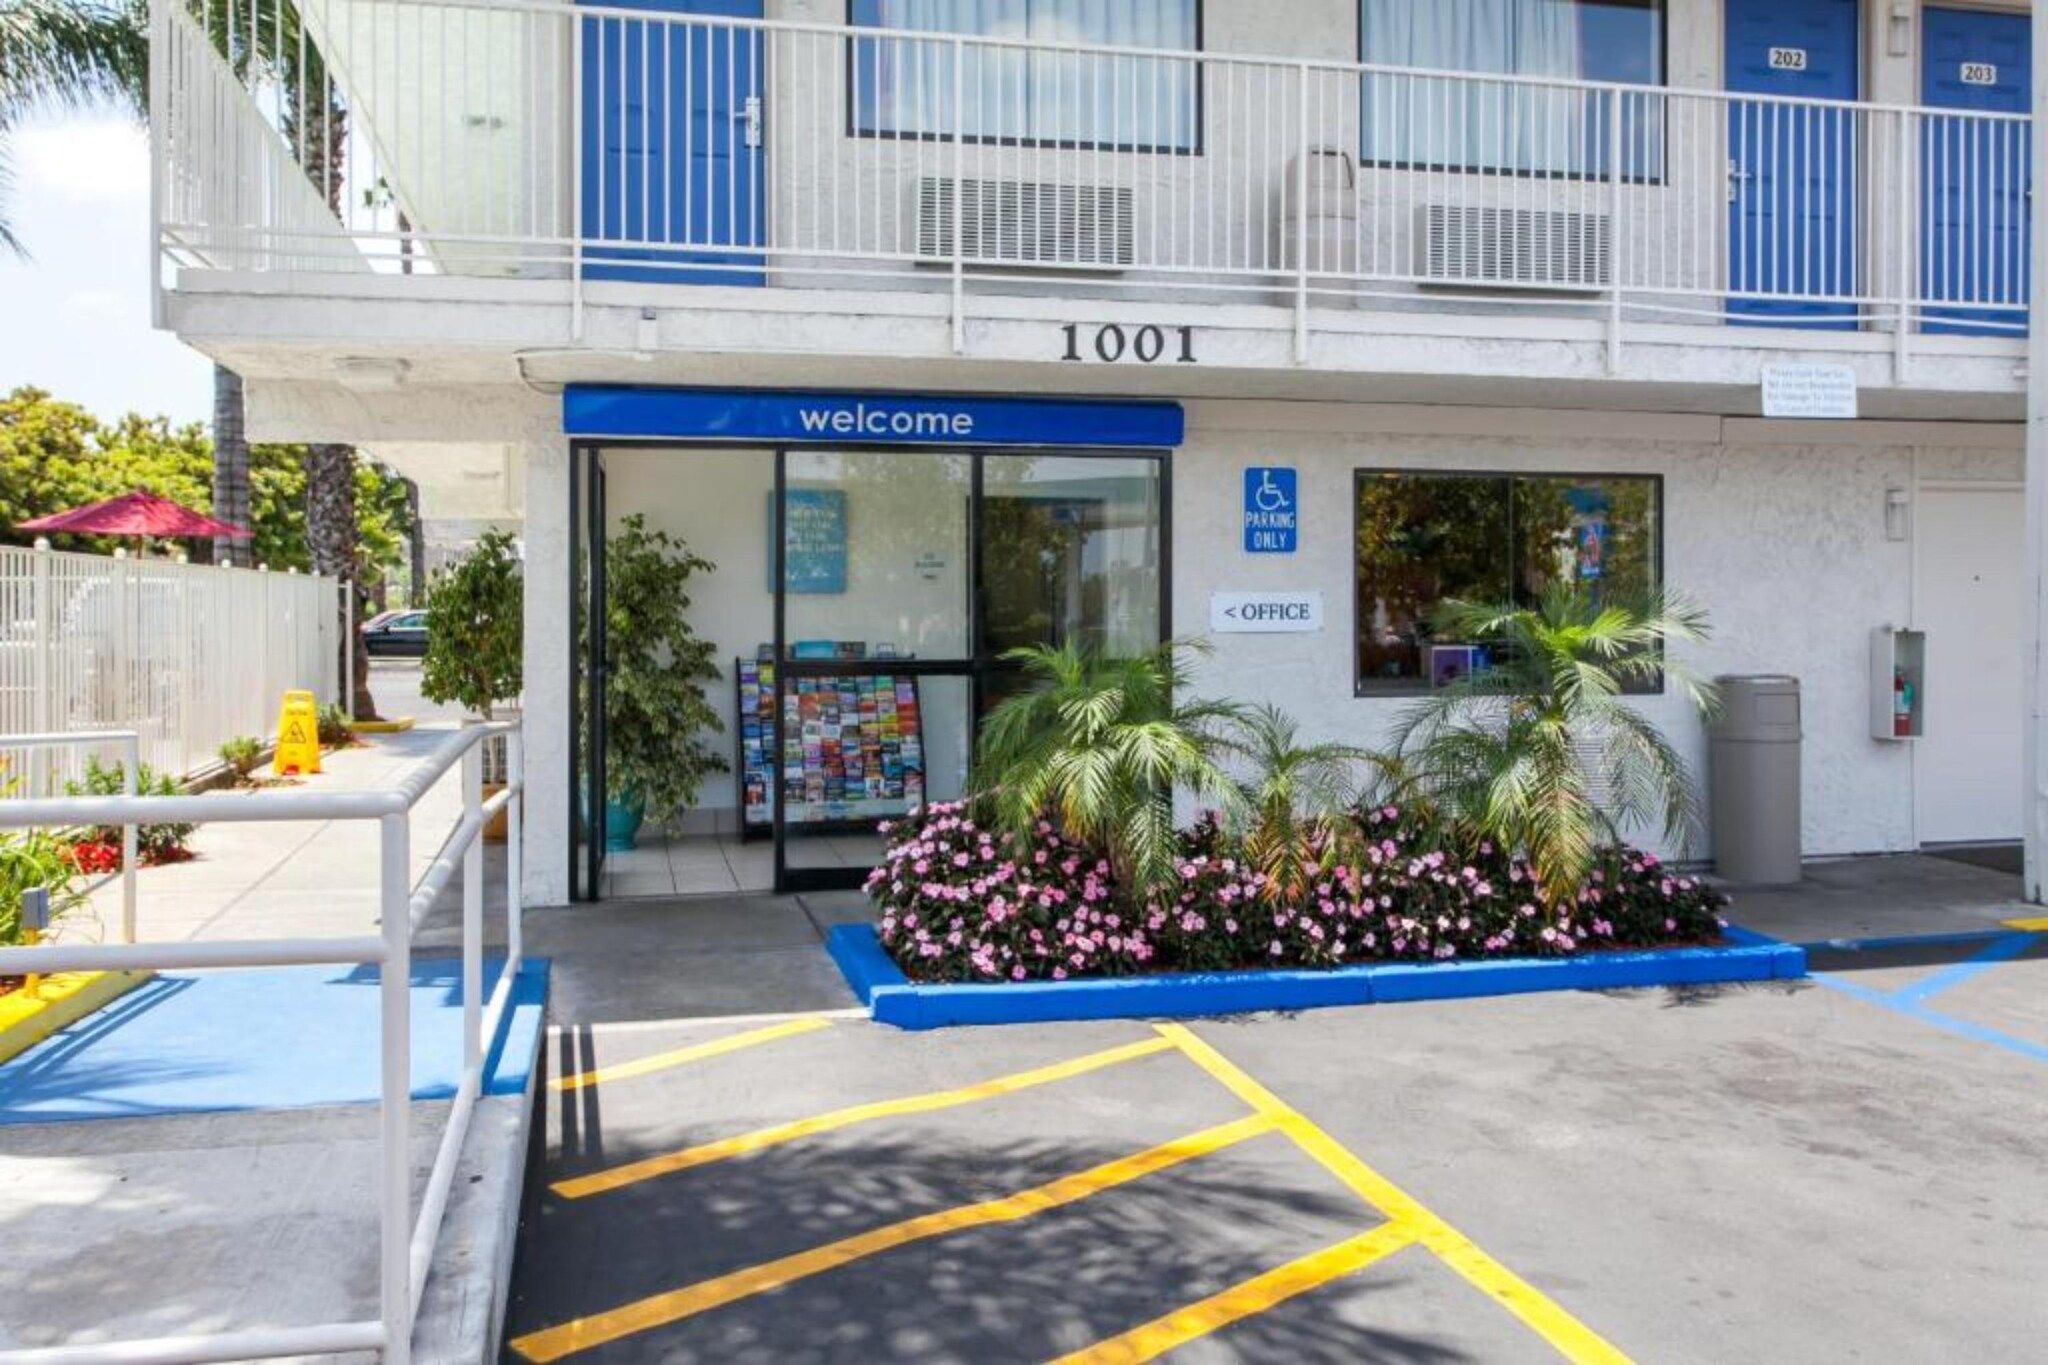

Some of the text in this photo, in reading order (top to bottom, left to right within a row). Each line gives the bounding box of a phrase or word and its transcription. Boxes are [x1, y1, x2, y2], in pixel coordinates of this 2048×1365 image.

[1773, 51, 1803, 67] 202
[1965, 66, 1993, 81] 203
[1061, 323, 1197, 363] 1001
[800, 403, 974, 436] welcome
[1246, 511, 1295, 529] PARKING
[1254, 532, 1287, 549] ONLY
[1241, 602, 1311, 621] OFFICE
